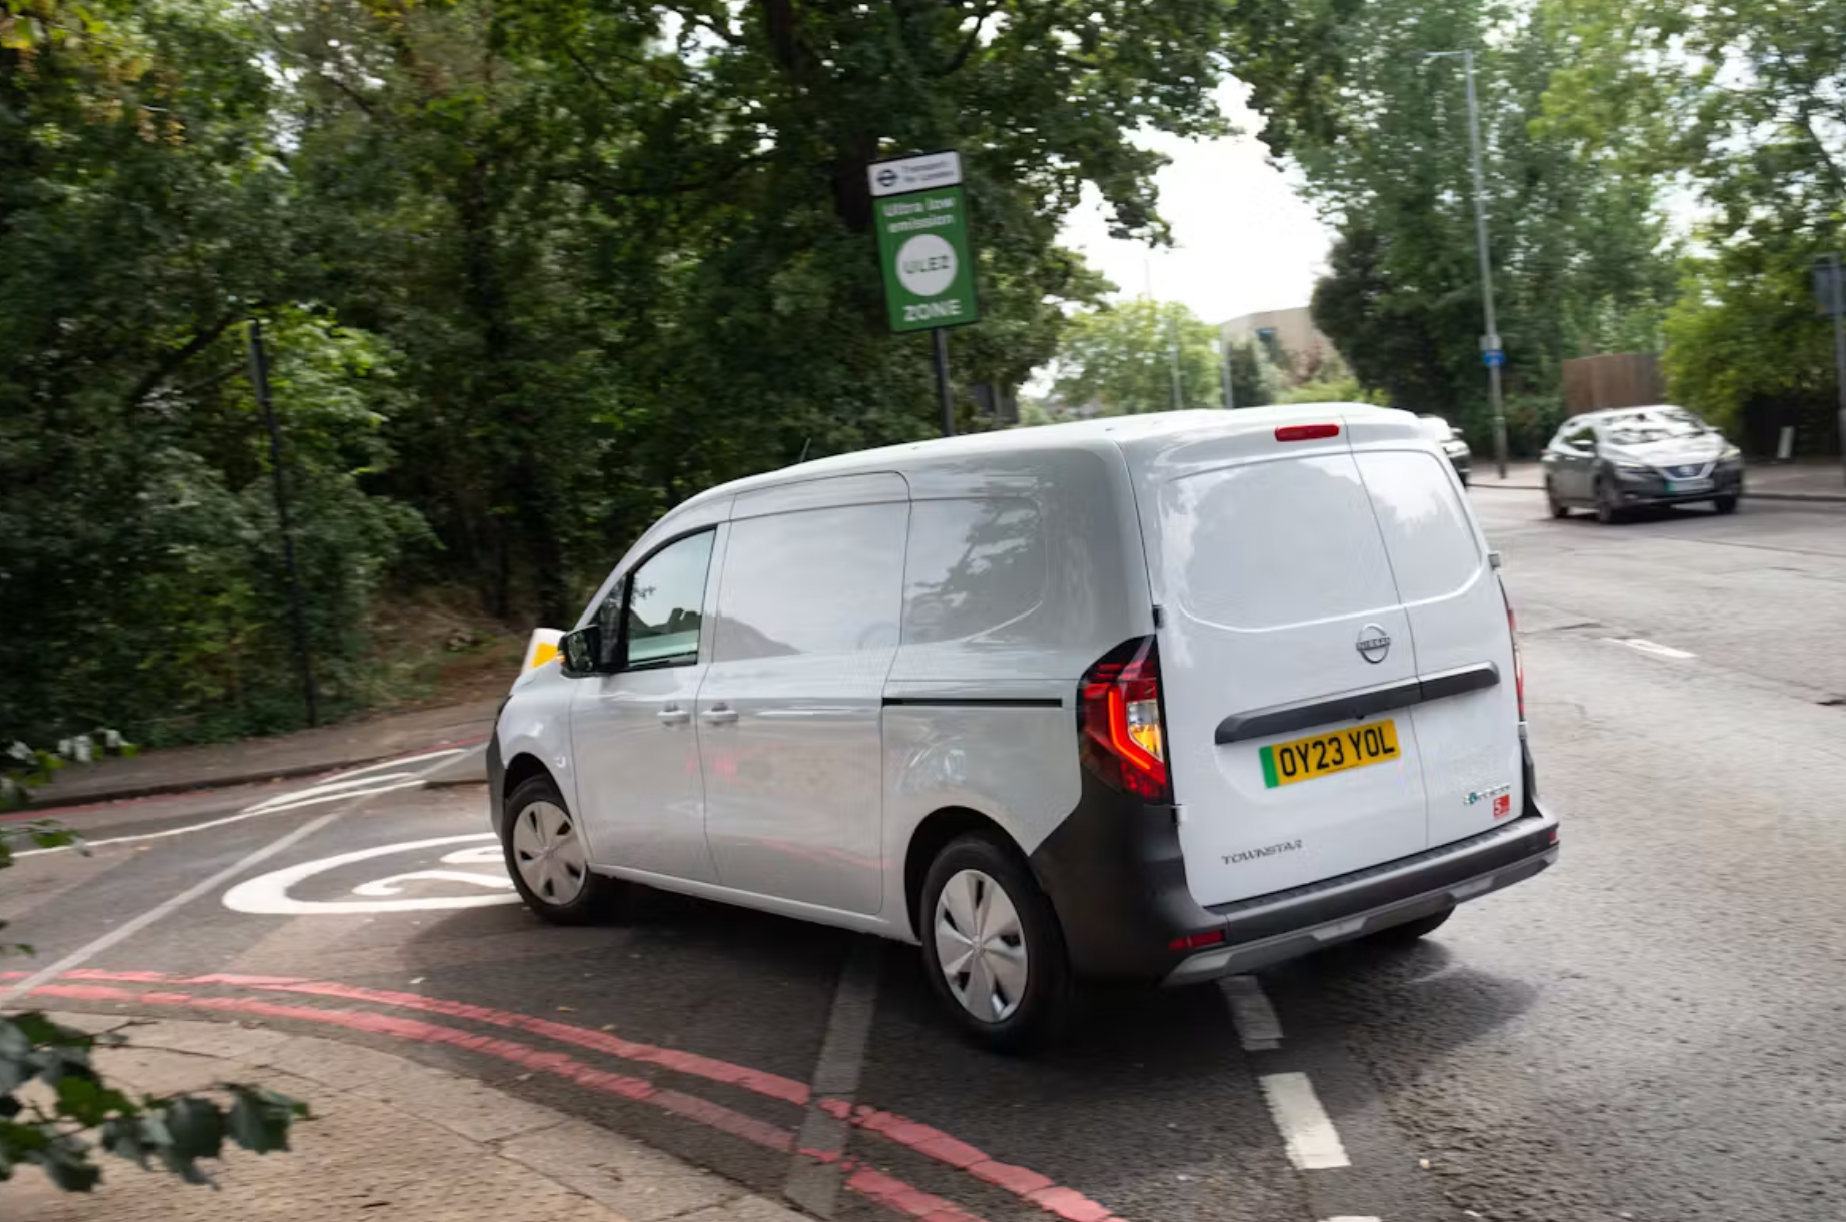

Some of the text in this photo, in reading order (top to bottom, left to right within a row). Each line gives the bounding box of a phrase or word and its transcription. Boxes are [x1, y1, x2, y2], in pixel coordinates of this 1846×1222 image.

[882, 197, 956, 218] Ultra low
[887, 214, 956, 233] emission
[903, 255, 951, 274] ULEZ
[902, 299, 962, 322] ZONE
[1279, 726, 1396, 778] OY23 YOL
[1221, 839, 1303, 865] TOWNSTAR
